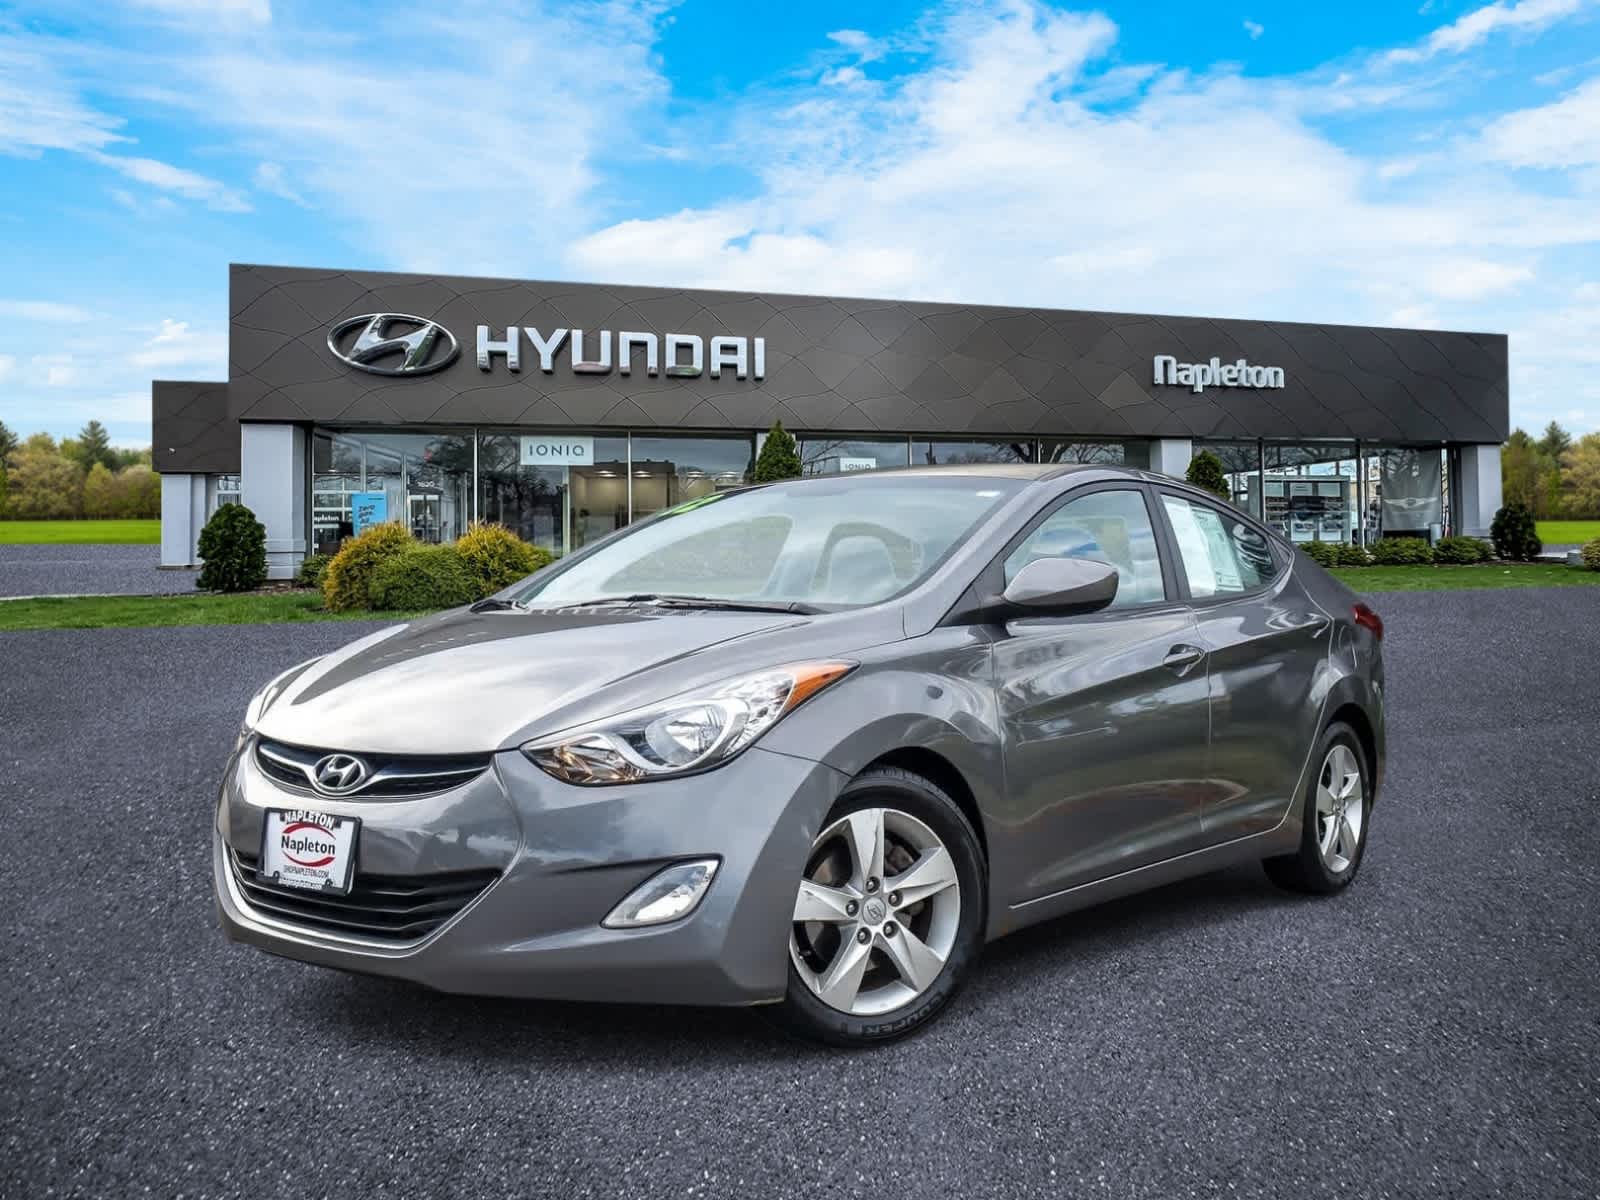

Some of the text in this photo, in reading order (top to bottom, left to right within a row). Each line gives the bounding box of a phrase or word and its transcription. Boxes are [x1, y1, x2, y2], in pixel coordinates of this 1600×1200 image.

[476, 325, 766, 381] HYUNDAI
[1153, 354, 1286, 393] Napleton
[529, 444, 585, 457] IONIQ
[284, 809, 335, 831] NAPLETON
[281, 835, 336, 855] Napleton
